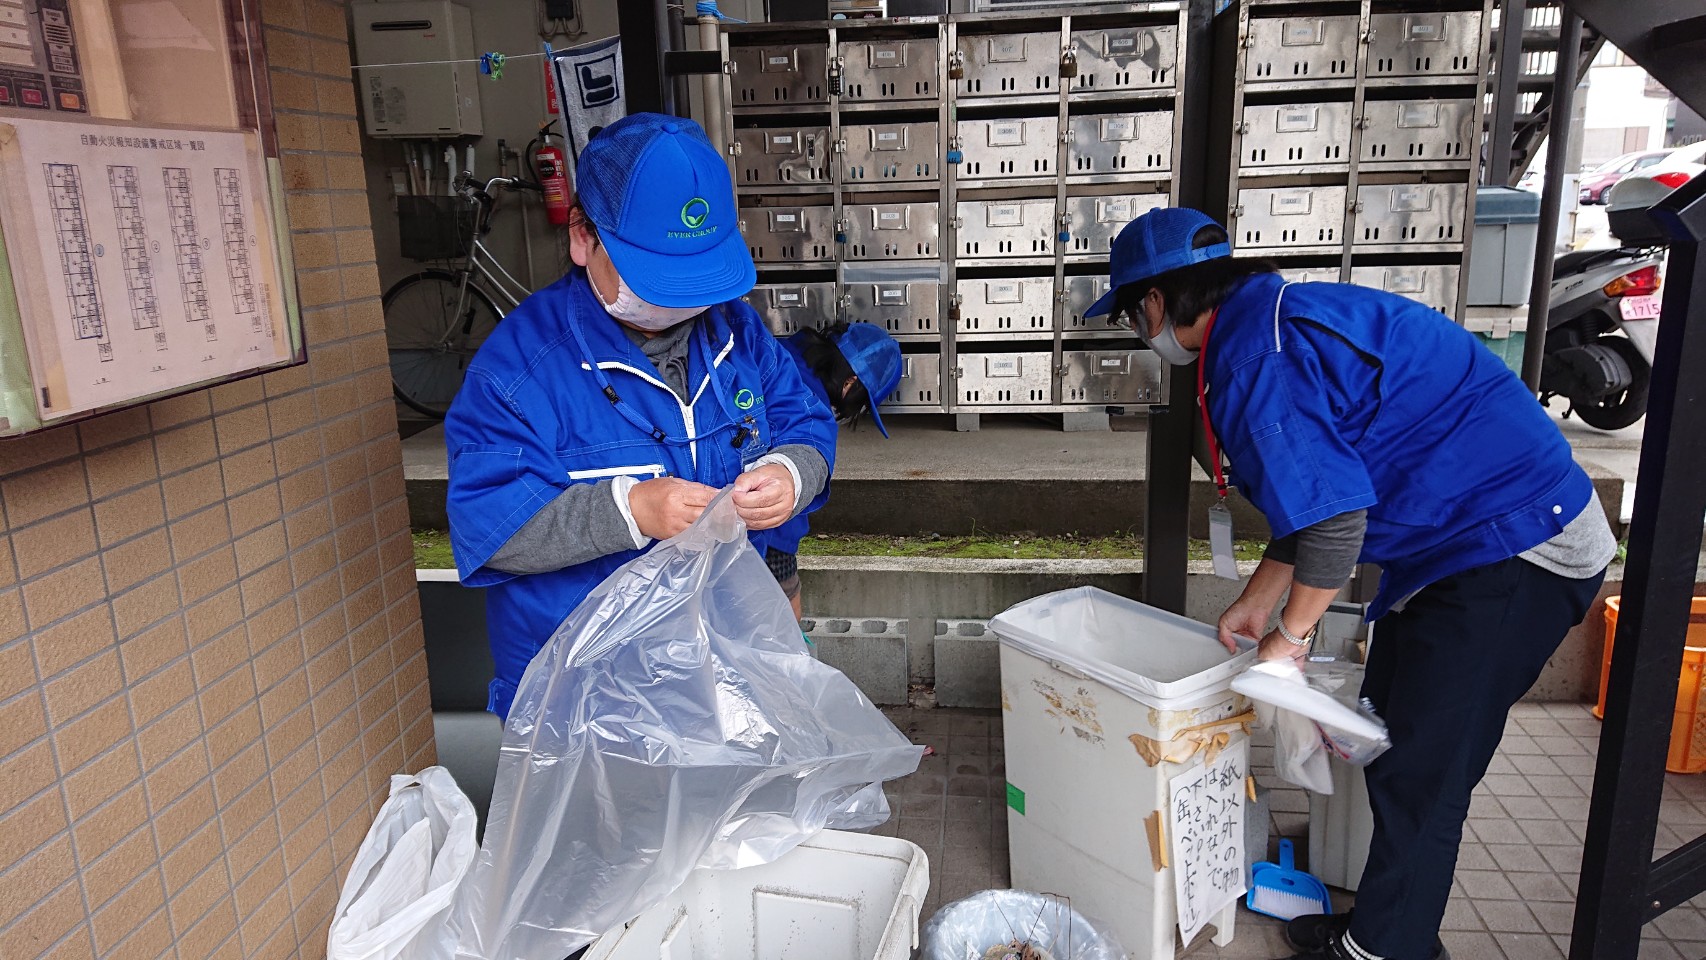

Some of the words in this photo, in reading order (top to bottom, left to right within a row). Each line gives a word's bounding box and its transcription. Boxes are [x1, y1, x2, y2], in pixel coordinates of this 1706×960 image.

[1633, 304, 1660, 316] 1715
[1218, 757, 1243, 893] 紙以外の物
